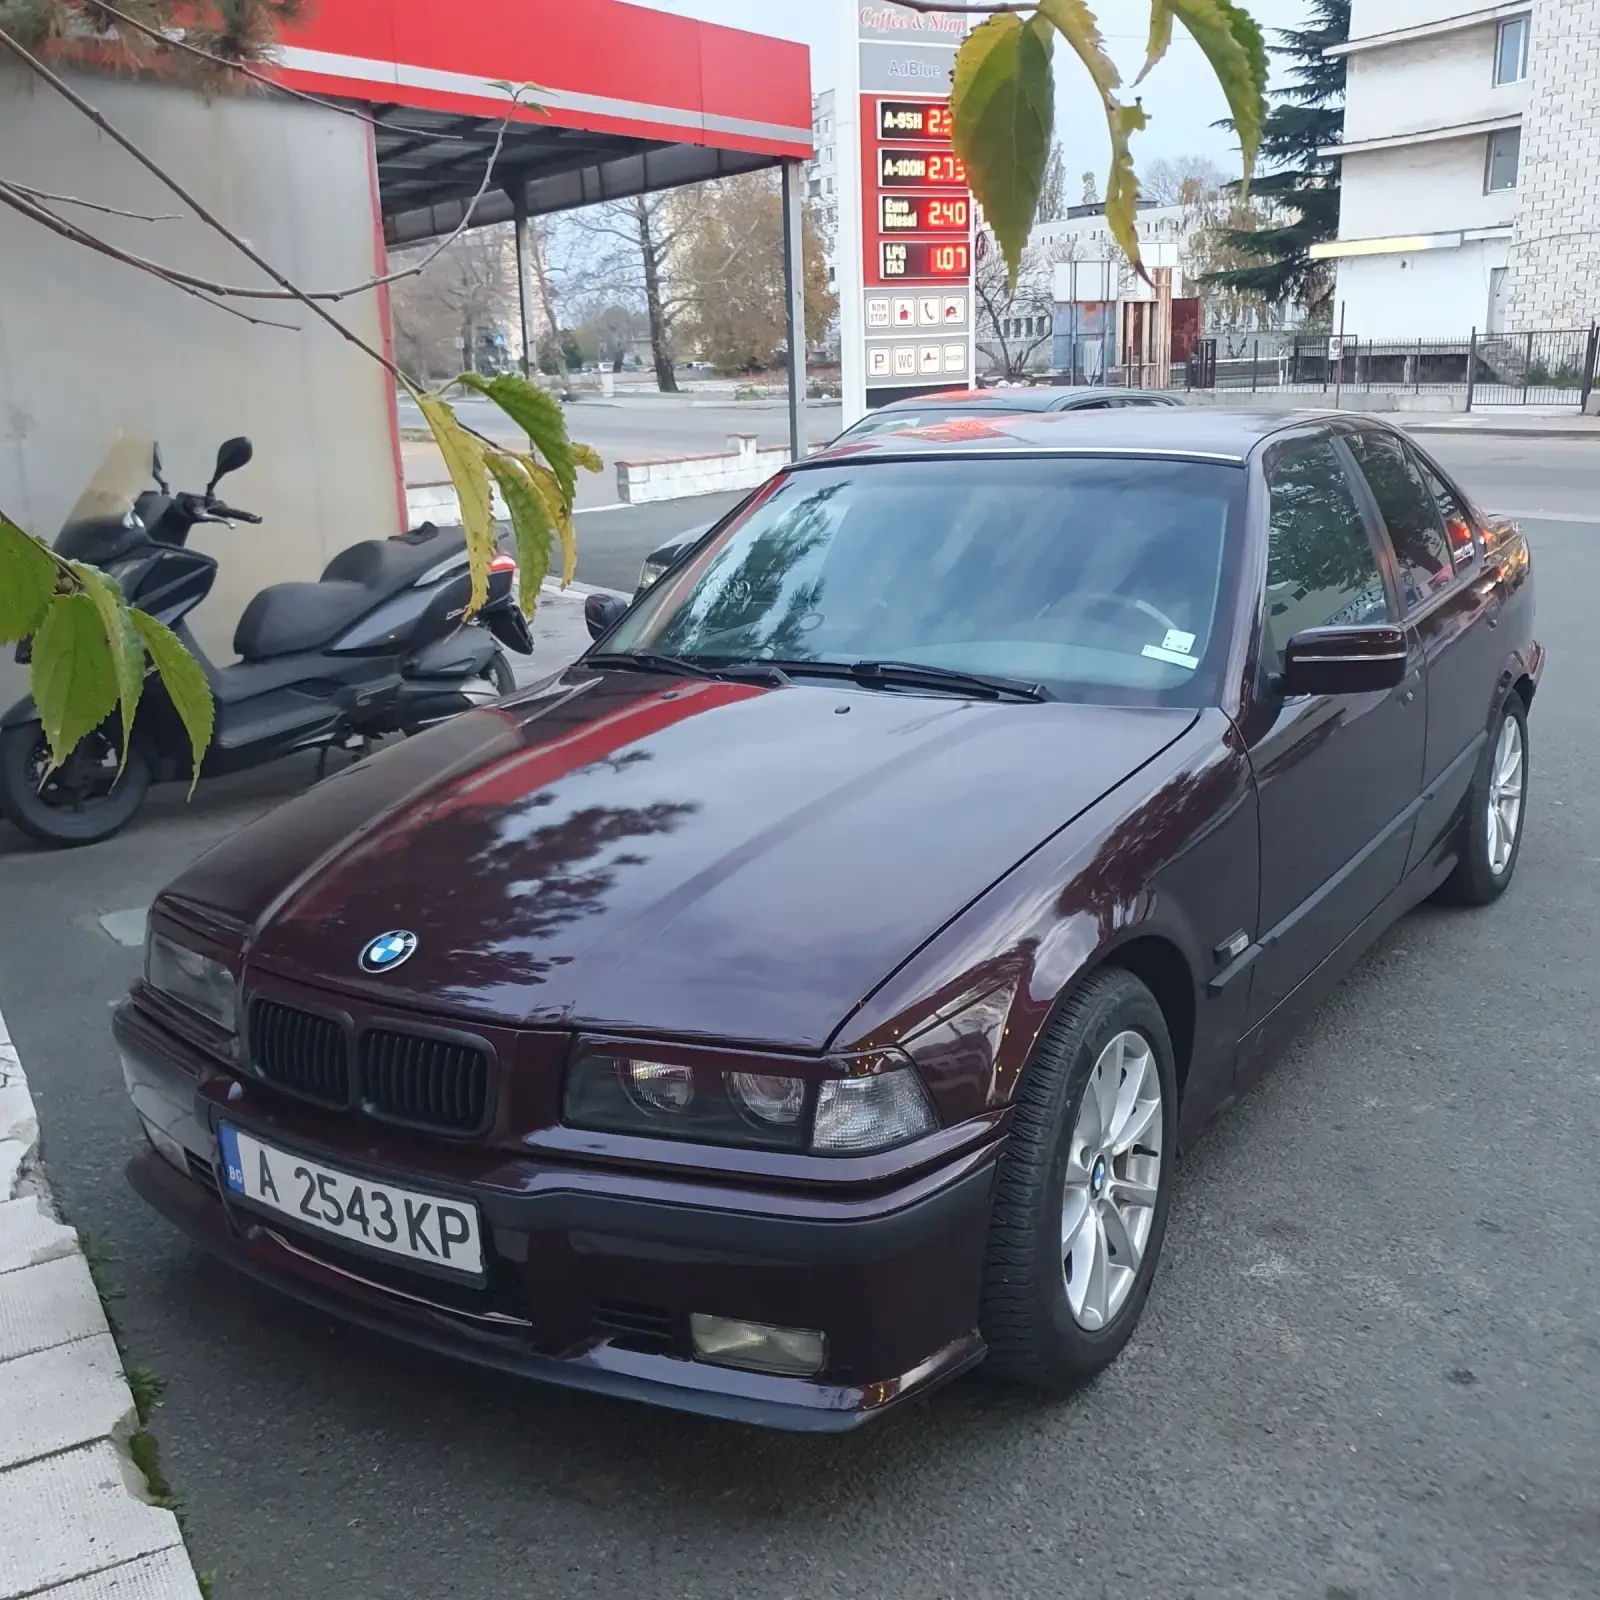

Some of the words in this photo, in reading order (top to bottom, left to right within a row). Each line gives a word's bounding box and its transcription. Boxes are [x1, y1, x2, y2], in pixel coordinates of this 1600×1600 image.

[859, 7, 908, 33] Coffee
[911, 12, 925, 31] &
[928, 11, 966, 37] Shop
[888, 60, 941, 77] AdBlue
[884, 198, 909, 213] Euro
[928, 201, 967, 226] 2.40
[884, 211, 918, 228] Diesel
[885, 244, 907, 260] LPG
[936, 246, 967, 270] 1.07
[871, 303, 886, 312] NON
[870, 313, 887, 322] STOP
[897, 353, 913, 369] WC
[228, 1164, 244, 1185] BG
[259, 1150, 280, 1203] A
